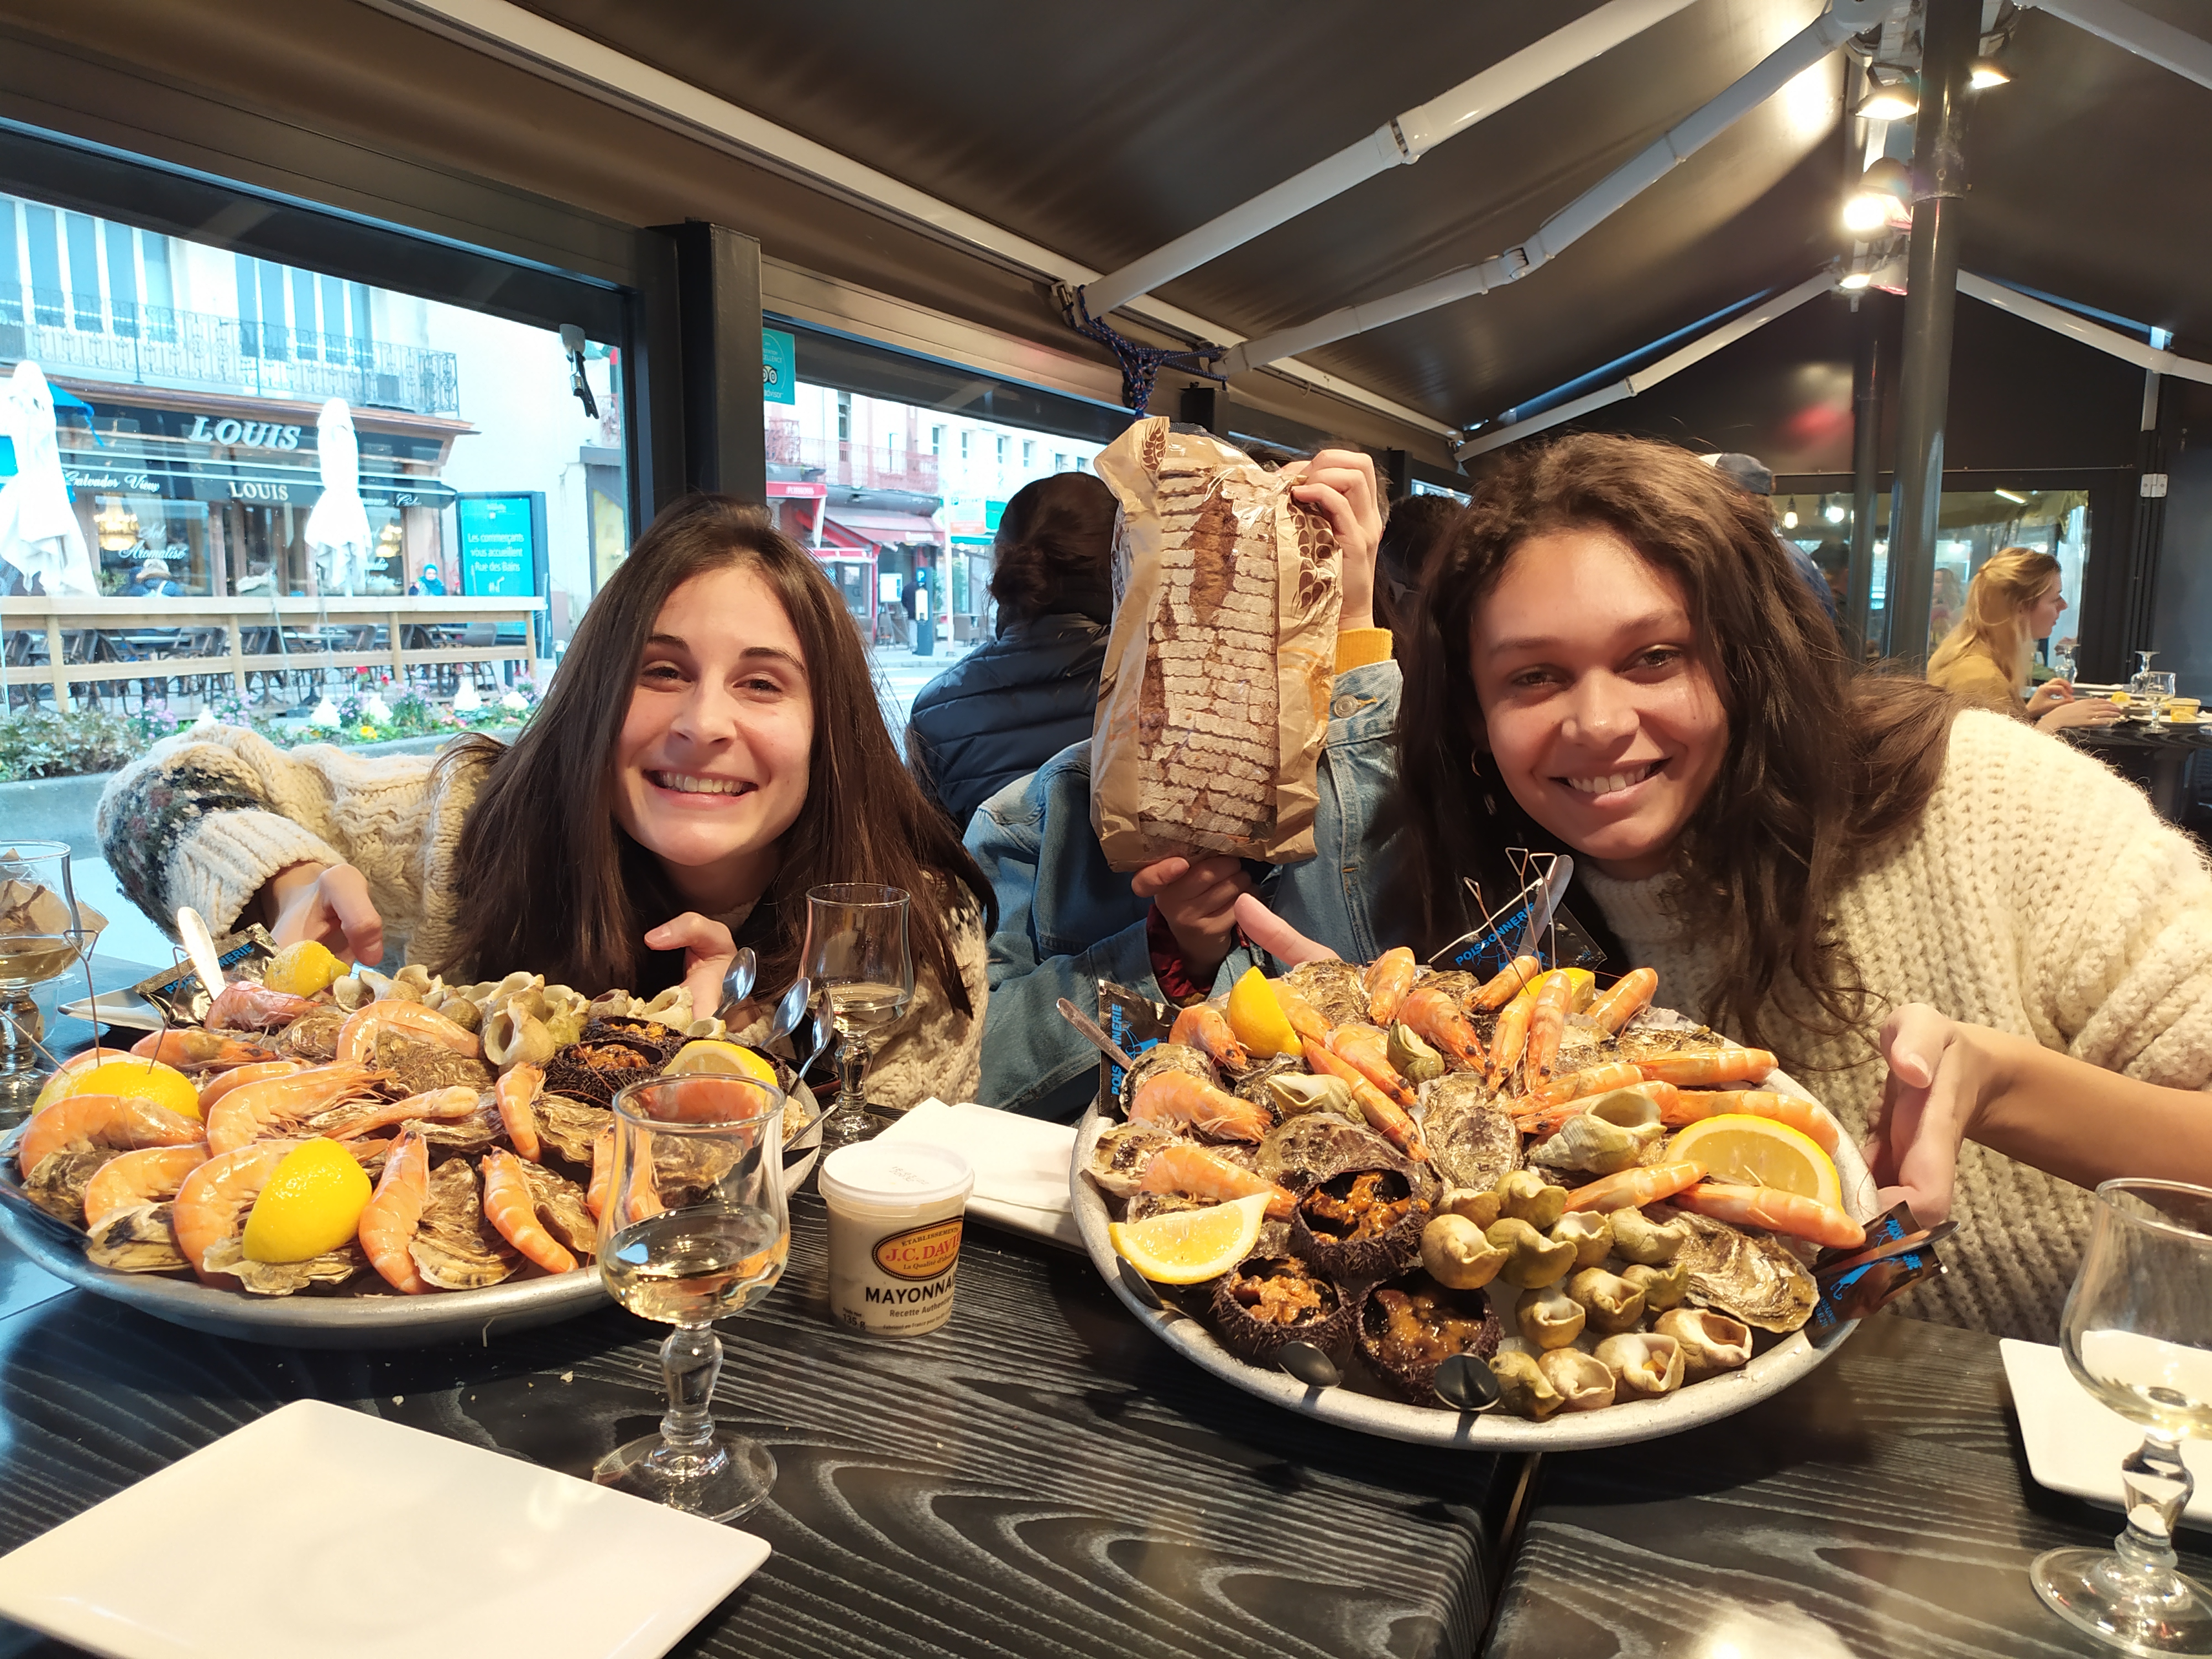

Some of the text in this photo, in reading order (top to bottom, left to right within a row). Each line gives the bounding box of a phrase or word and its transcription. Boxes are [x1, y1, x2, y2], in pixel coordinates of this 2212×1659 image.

[189, 415, 301, 450] LOUIS
[229, 482, 289, 501] LOUIS
[467, 533, 524, 545] Les commerçants
[471, 548, 487, 557] vous
[474, 561, 520, 571] Rue des Bains
[1454, 902, 1535, 966] POISSONNERIE
[1112, 1003, 1122, 1095] POISNNERIE
[885, 1248, 919, 1261] J.C.
[913, 1260, 936, 1270] Qualité
[843, 1314, 865, 1330] 135 g
